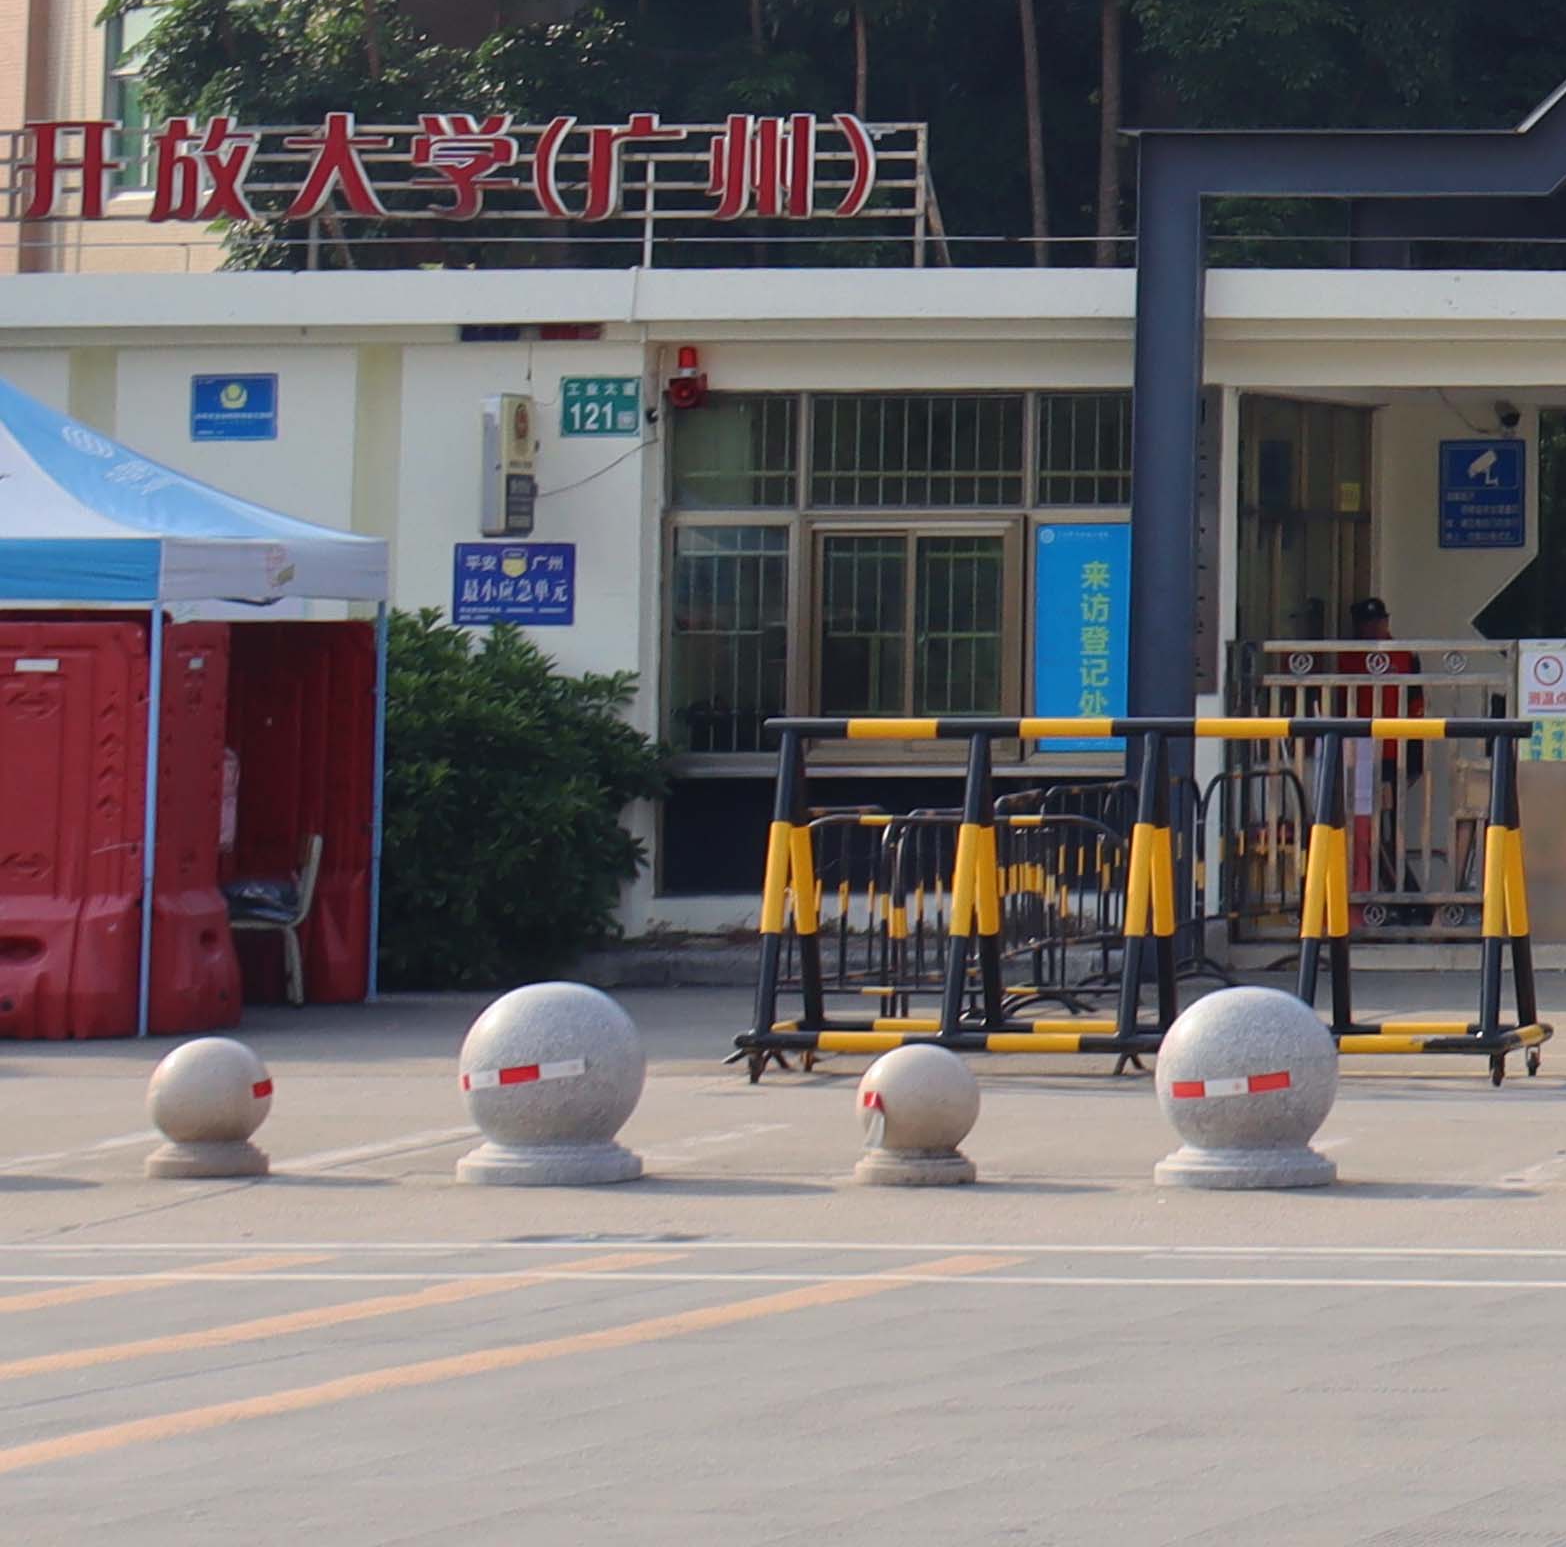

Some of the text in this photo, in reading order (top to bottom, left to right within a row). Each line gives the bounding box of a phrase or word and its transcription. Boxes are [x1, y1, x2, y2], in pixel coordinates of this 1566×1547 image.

[570, 401, 614, 430] 121
[1079, 560, 1111, 718] 来访登记处
